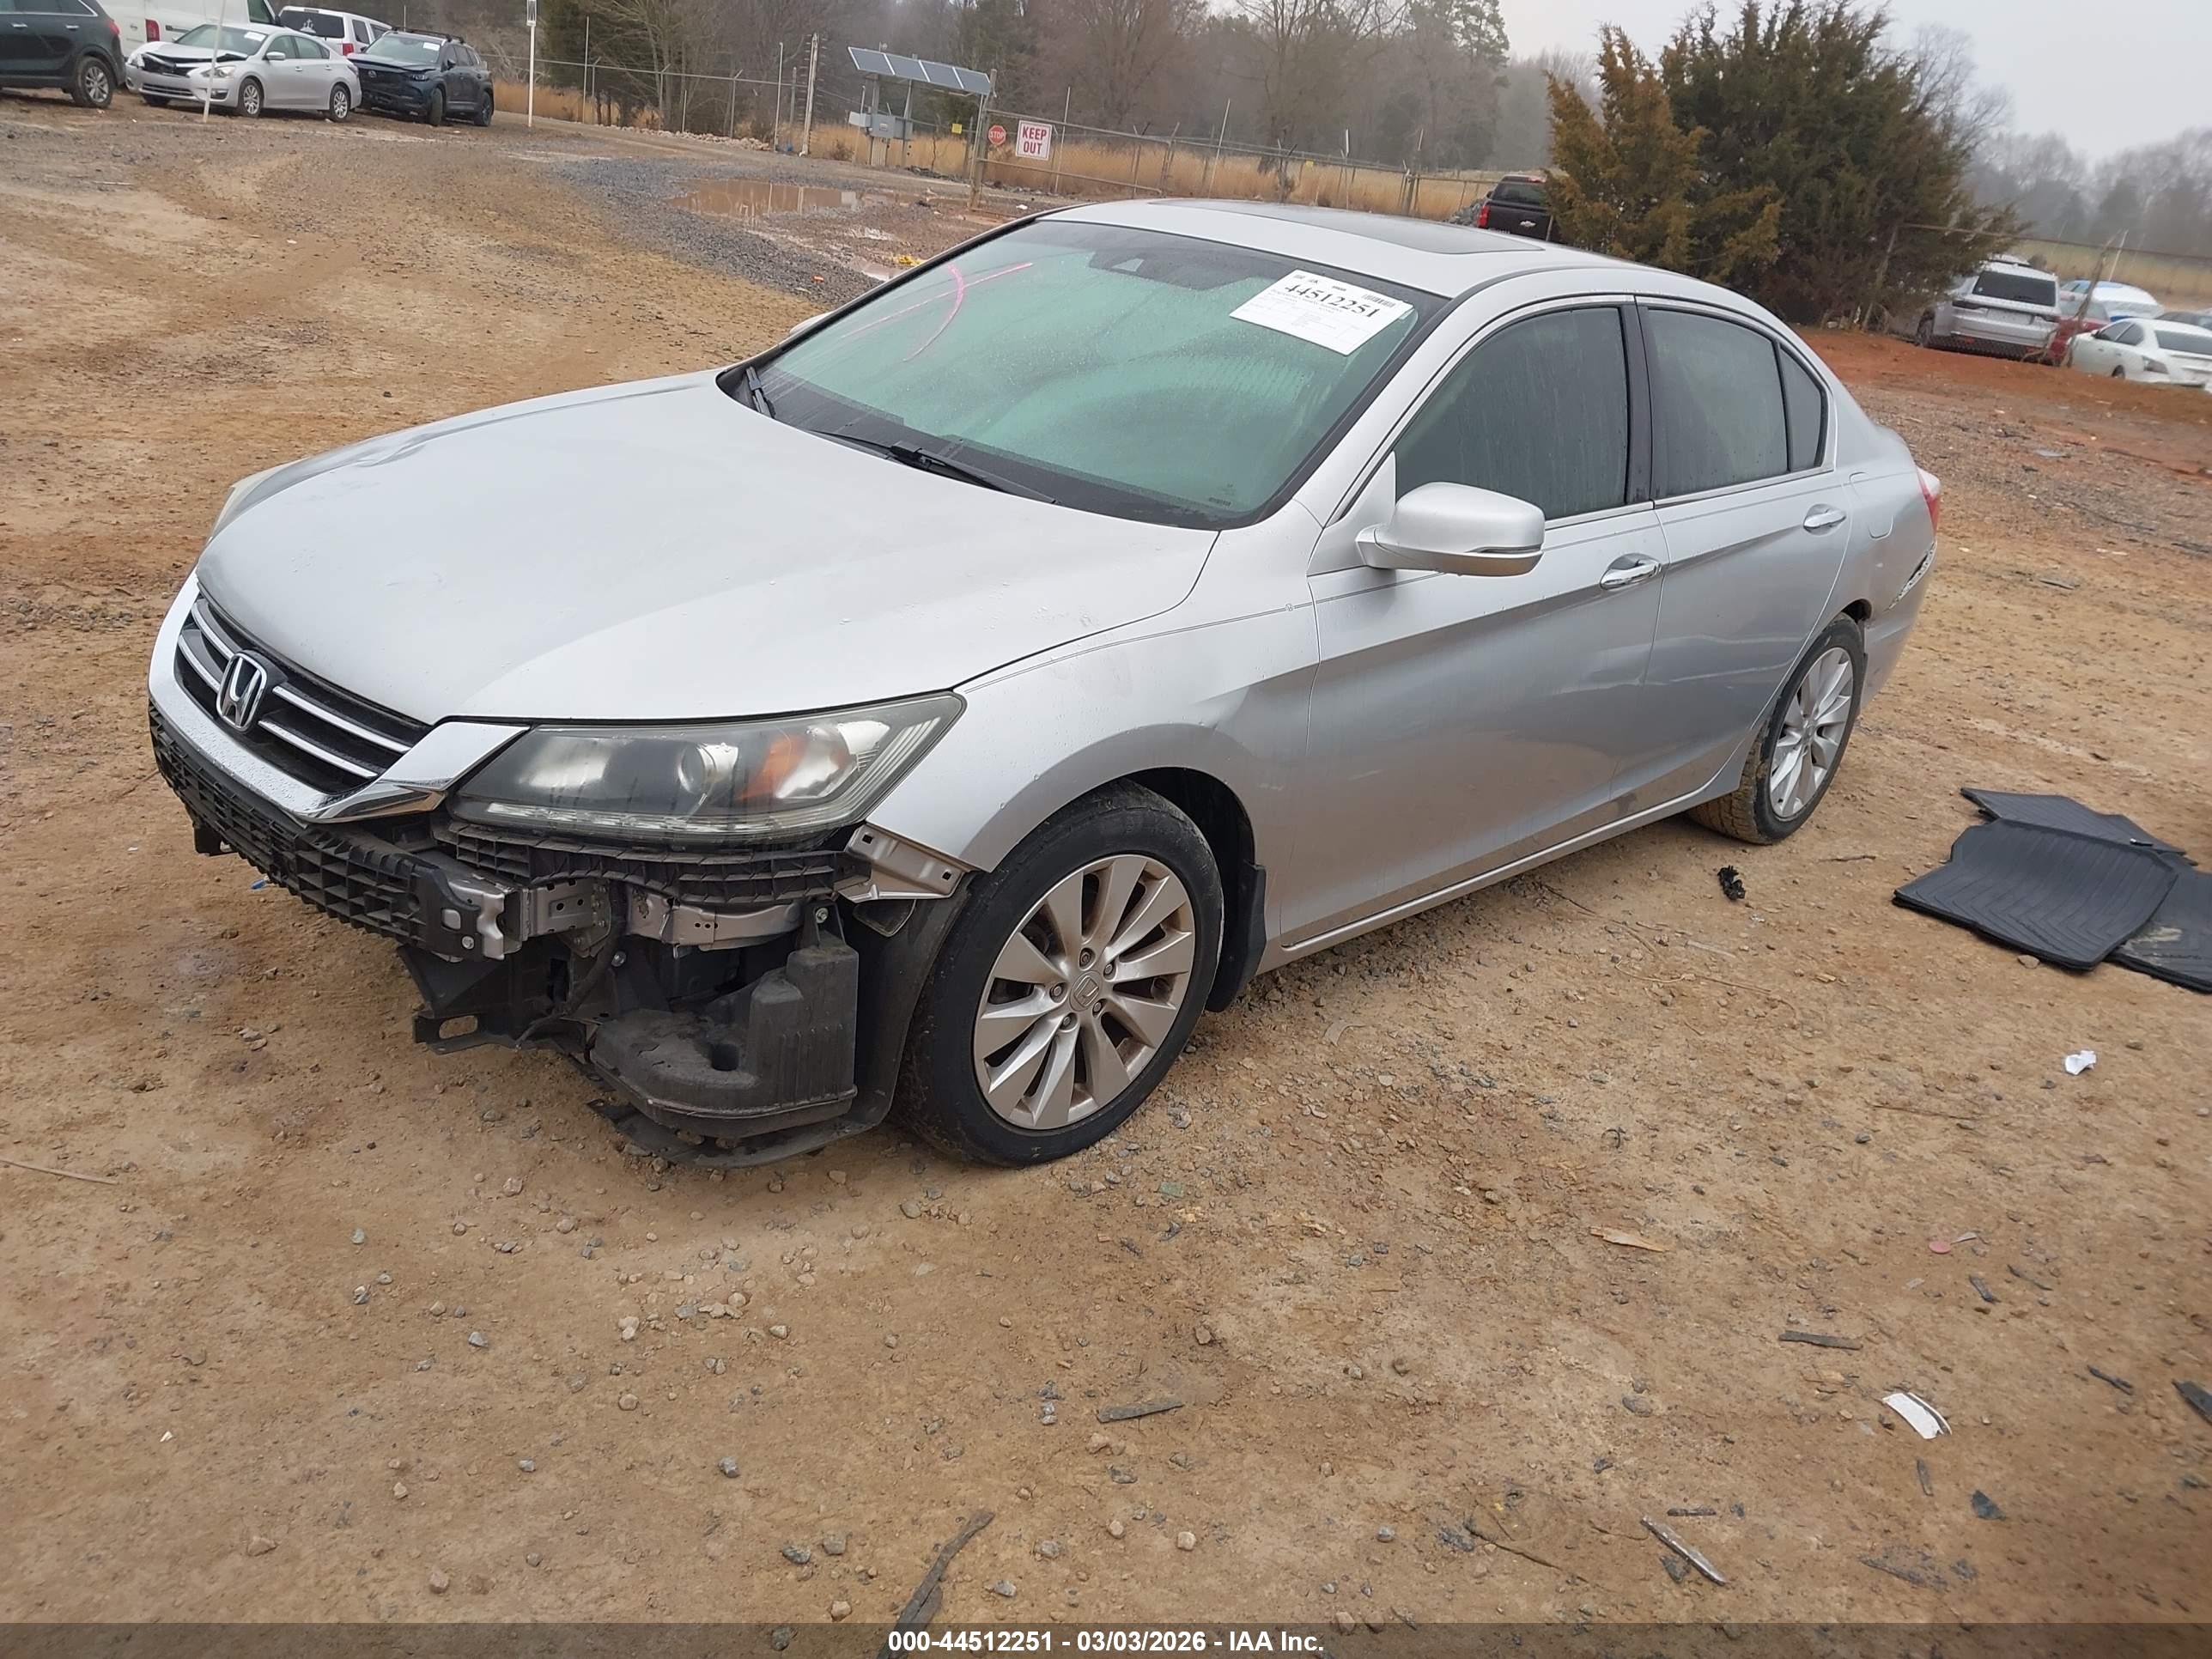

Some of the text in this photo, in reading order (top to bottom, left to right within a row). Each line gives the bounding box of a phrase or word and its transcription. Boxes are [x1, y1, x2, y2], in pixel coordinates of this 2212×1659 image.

[1022, 125, 1047, 141] KEEP
[1023, 141, 1042, 155] OUT
[1285, 284, 1380, 318] 44512251
